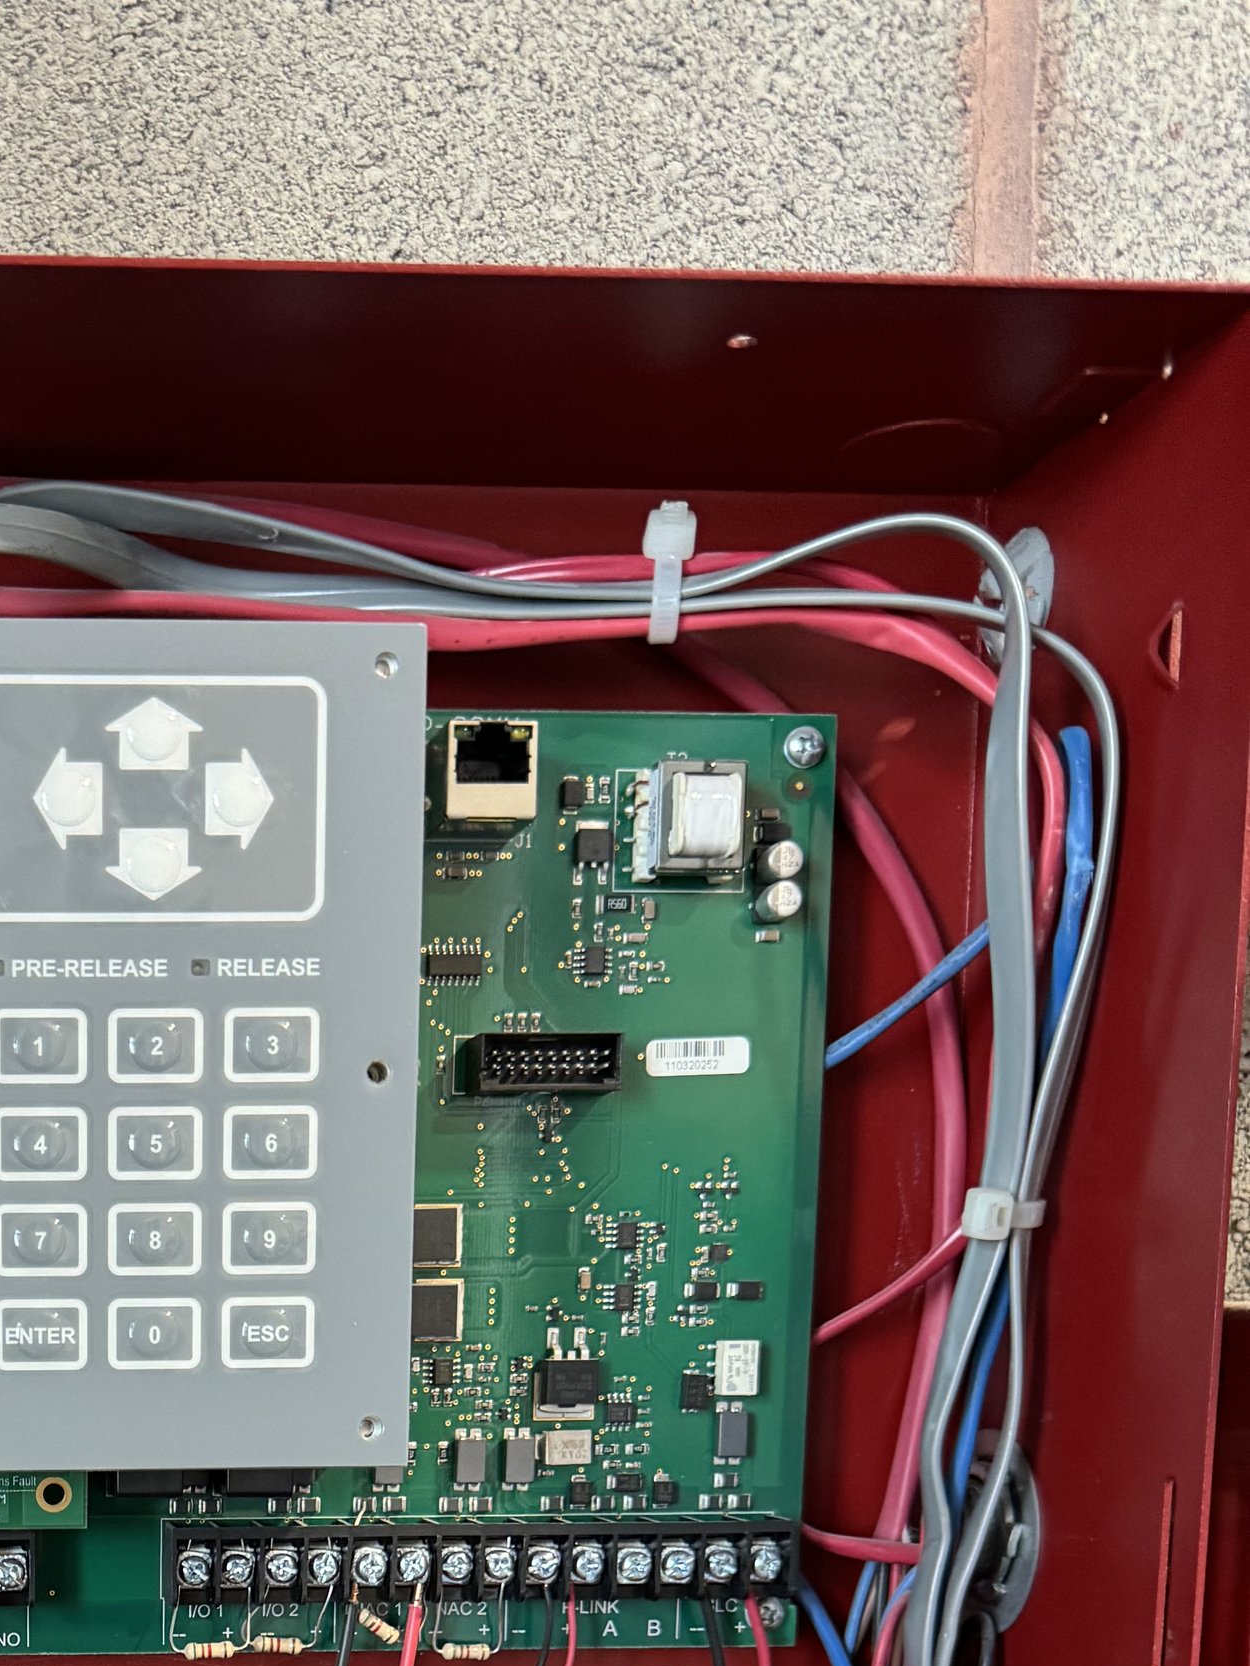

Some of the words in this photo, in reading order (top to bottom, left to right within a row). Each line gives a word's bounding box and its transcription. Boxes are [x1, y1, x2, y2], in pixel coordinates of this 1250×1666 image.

[11, 958, 169, 978] PRE-RELEASE
[217, 957, 322, 977] RELEASE
[33, 1036, 43, 1057] 1
[150, 1036, 164, 1056] 2
[266, 1035, 280, 1055] 3
[664, 1059, 719, 1072] 110320252
[33, 1134, 48, 1155] 4
[149, 1134, 163, 1154] 5
[264, 1133, 278, 1153] 6
[34, 1231, 47, 1250] 7
[149, 1230, 162, 1250] 8
[263, 1229, 276, 1249] 9
[4, 1326, 77, 1345] ENTER
[148, 1325, 161, 1345] 0
[246, 1324, 290, 1343] ESC
[12, 1476, 37, 1487] Fault
[188, 1604, 211, 1618] I/O
[262, 1603, 283, 1618] I/O
[288, 1603, 299, 1617] 2
[439, 1602, 471, 1616] NAC
[476, 1602, 487, 1616] 2
[602, 1620, 618, 1637] A
[647, 1620, 662, 1636] B
